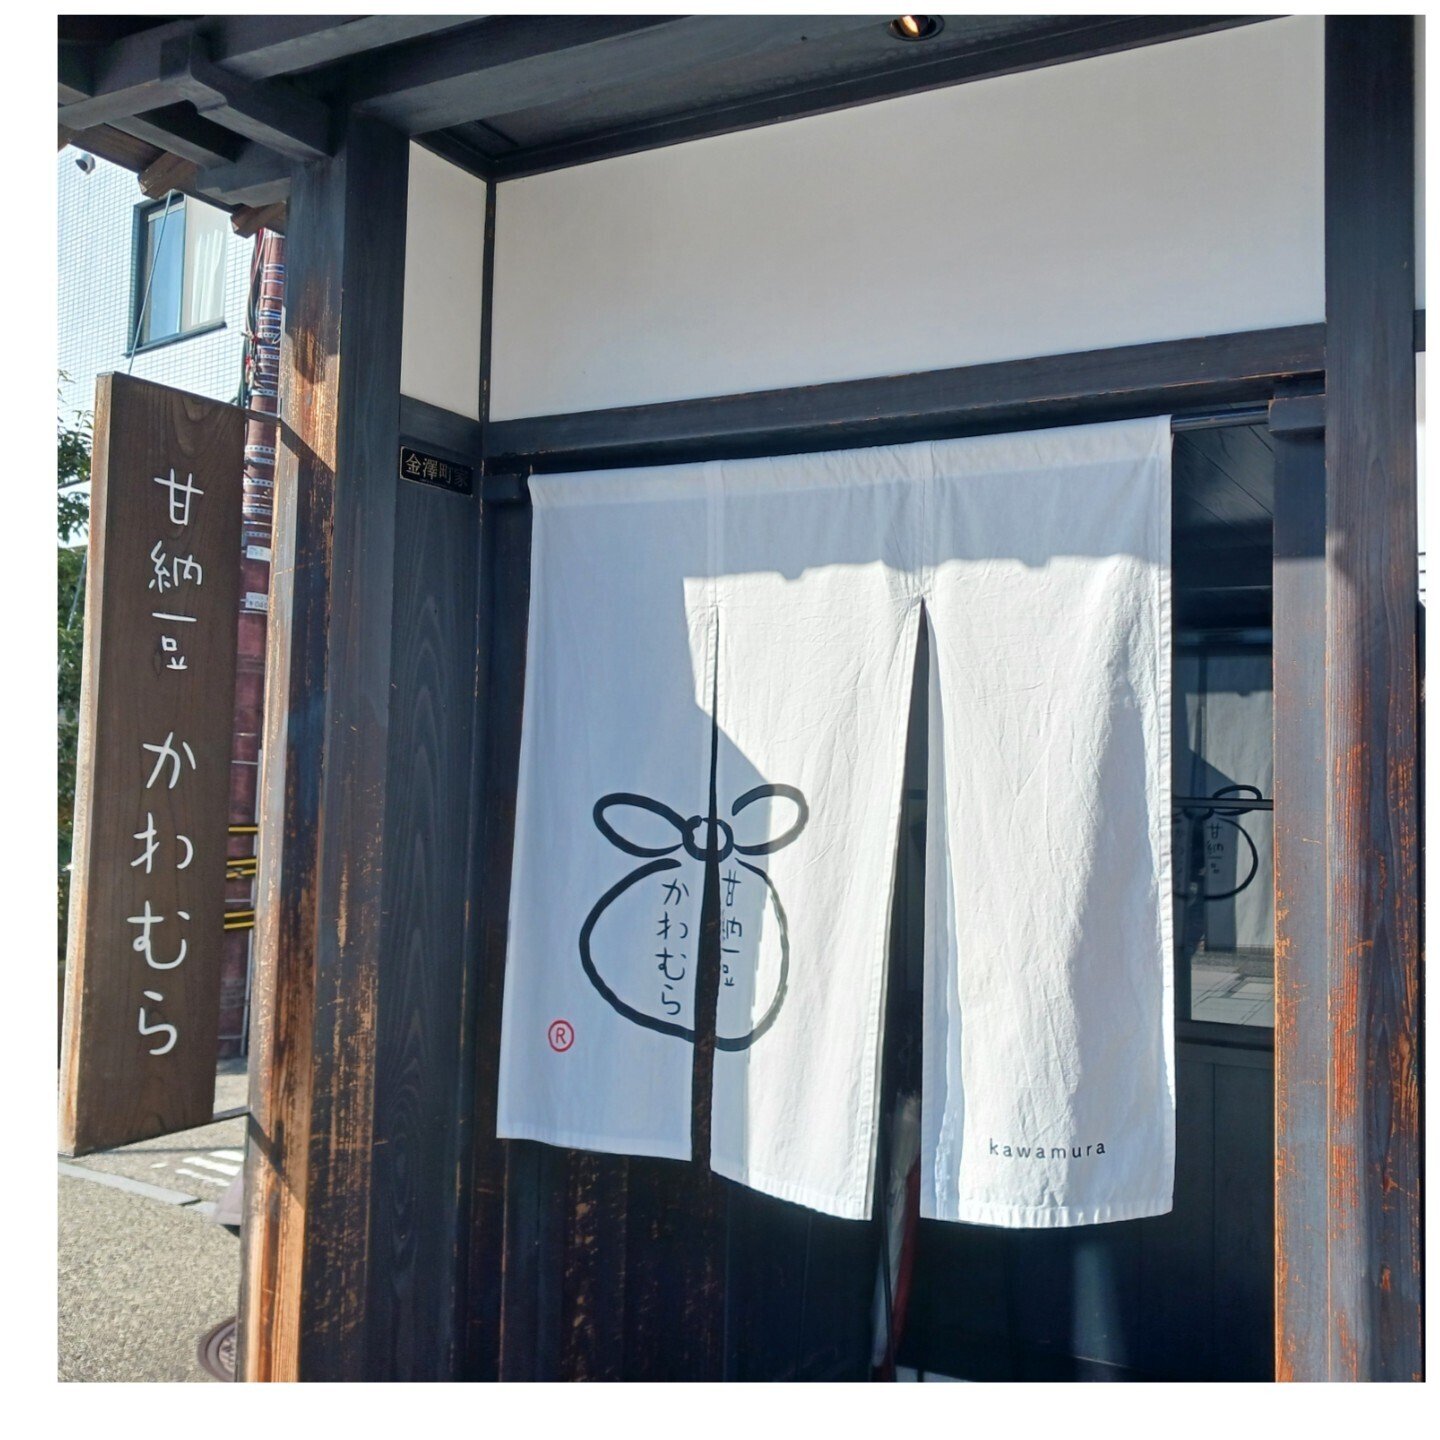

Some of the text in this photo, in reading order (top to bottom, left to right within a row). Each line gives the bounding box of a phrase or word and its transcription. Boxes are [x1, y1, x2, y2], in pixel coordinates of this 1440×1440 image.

[126, 467, 205, 1056] 甘納豆 かわむら
[654, 877, 690, 1016] かわむら
[719, 868, 743, 988] 甘納豆
[989, 1137, 1106, 1159] kawamura
